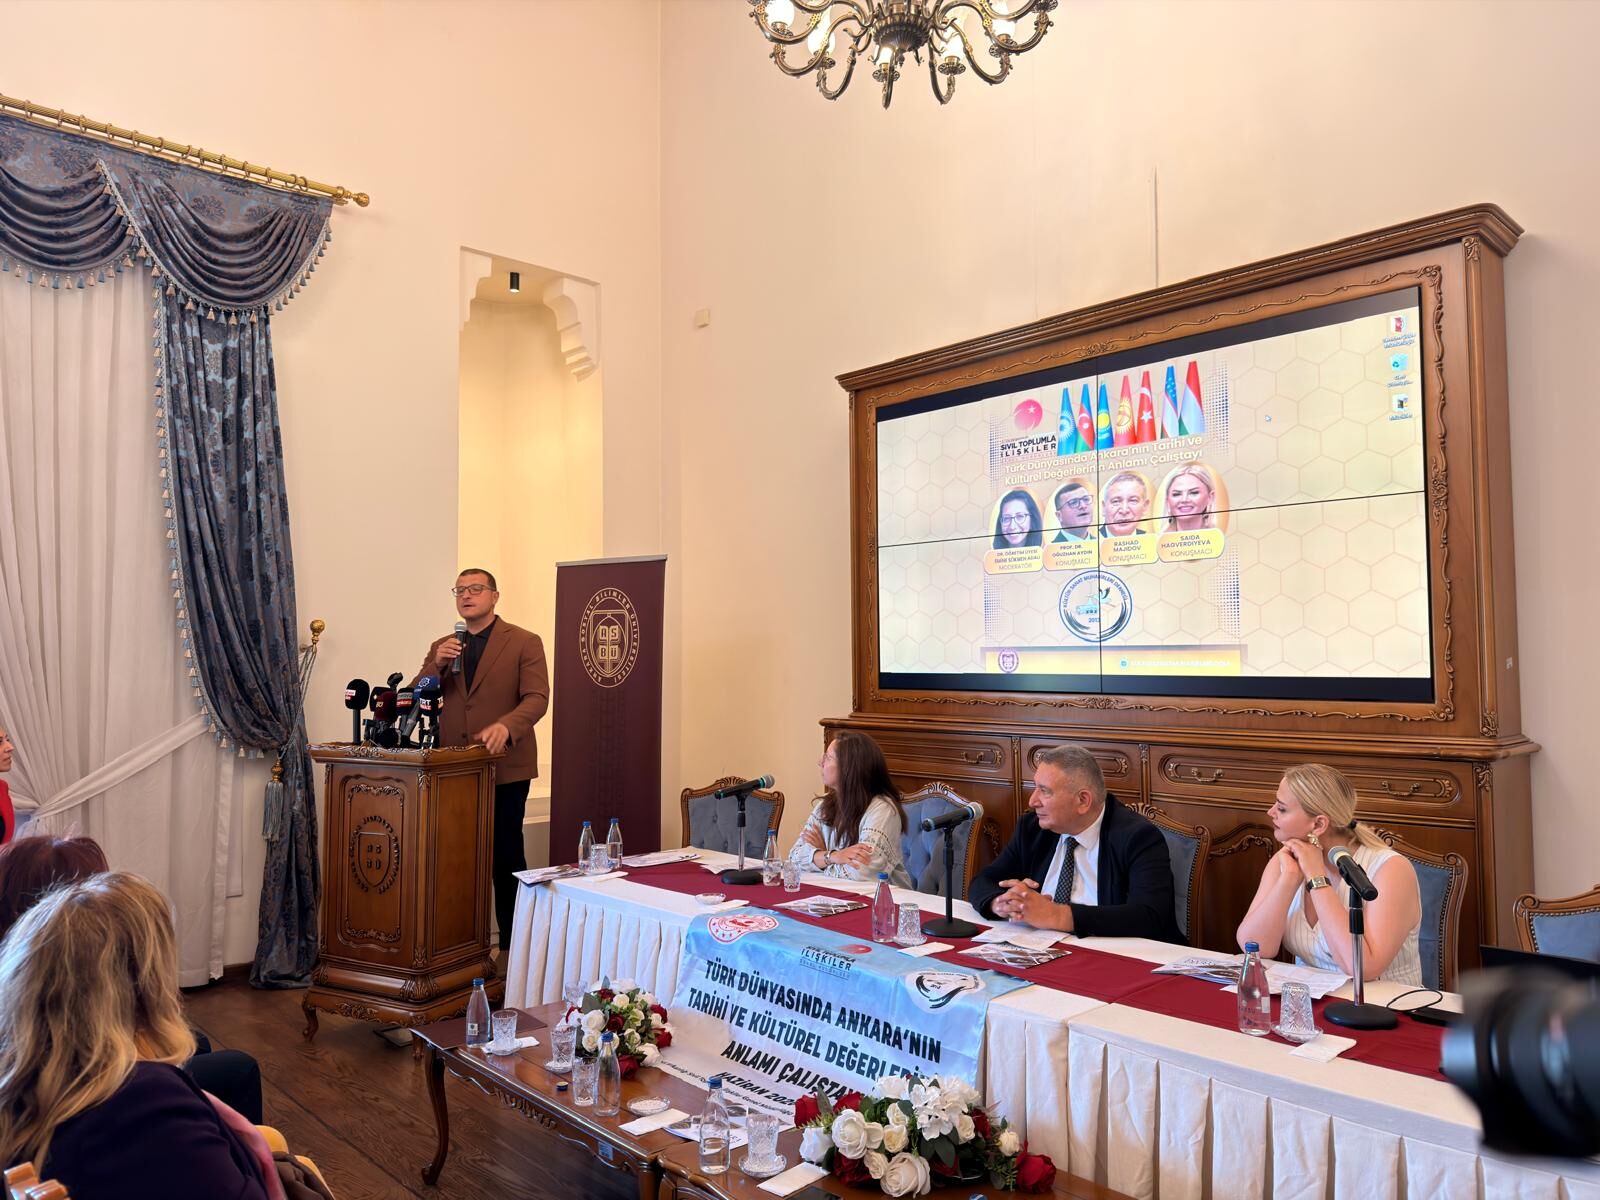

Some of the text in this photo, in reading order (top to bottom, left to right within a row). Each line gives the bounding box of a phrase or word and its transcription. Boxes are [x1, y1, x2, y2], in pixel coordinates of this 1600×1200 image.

[1005, 463, 1025, 473] Türk
[1027, 454, 1087, 471] Dünyasında
[1152, 438, 1185, 451] Tarihi
[1187, 436, 1202, 446] ve
[1019, 435, 1056, 447] TOPLUMLA
[1005, 451, 1202, 486] Kültürel Değerlerinn Anlamı Çalıştayı
[705, 956, 737, 988] TÜRK
[737, 970, 832, 1024] DÜNYASINDA
[687, 987, 730, 1021] TARİHİ
[730, 1001, 748, 1028] VE
[748, 1009, 821, 1057] KÜLTÜREL
[721, 1041, 781, 1075] ANLAMI
[715, 1071, 796, 1106] HAZİRAN 202
